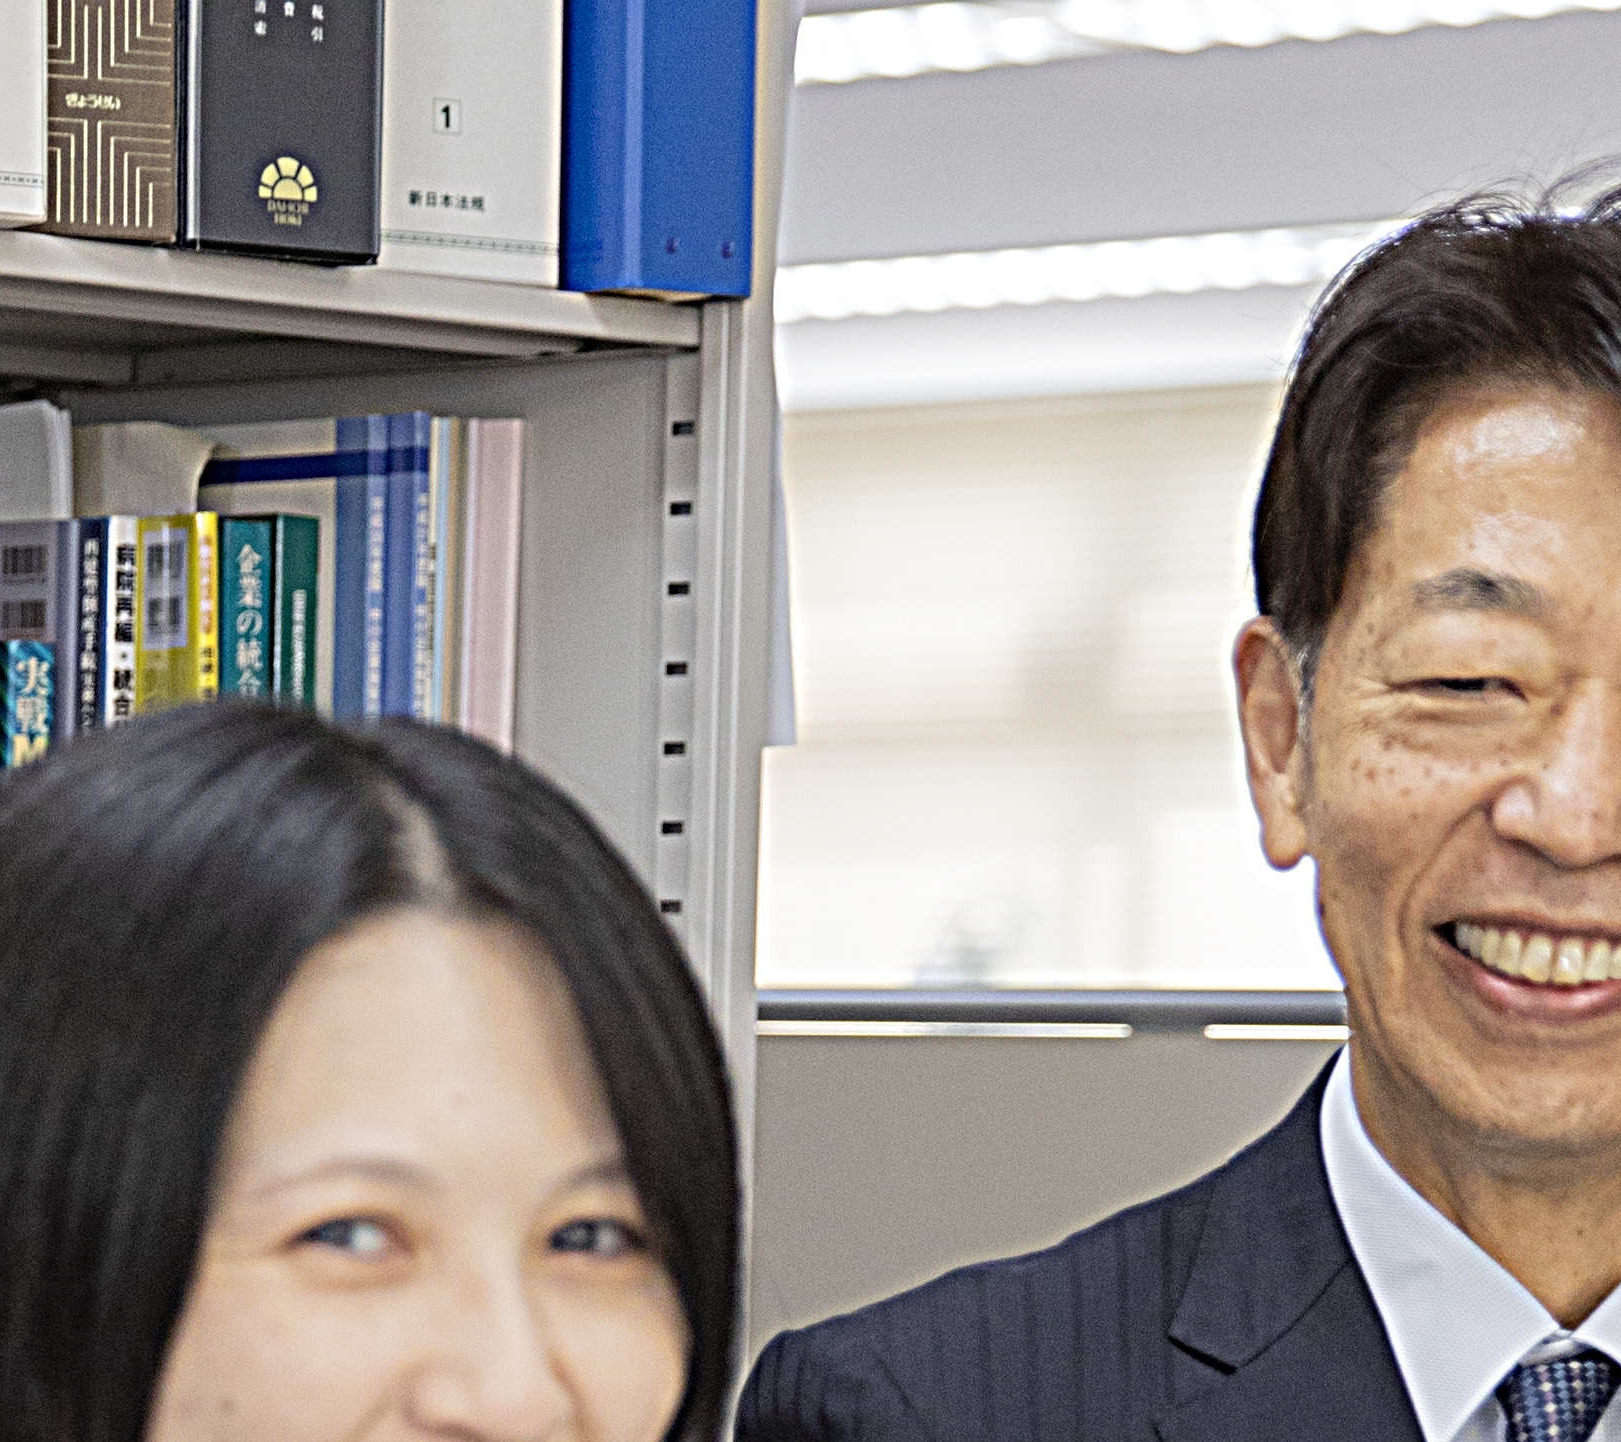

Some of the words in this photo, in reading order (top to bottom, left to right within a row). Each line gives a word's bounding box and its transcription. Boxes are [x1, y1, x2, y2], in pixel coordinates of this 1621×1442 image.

[440, 103, 454, 131] 1
[408, 188, 486, 214] 新日本法規
